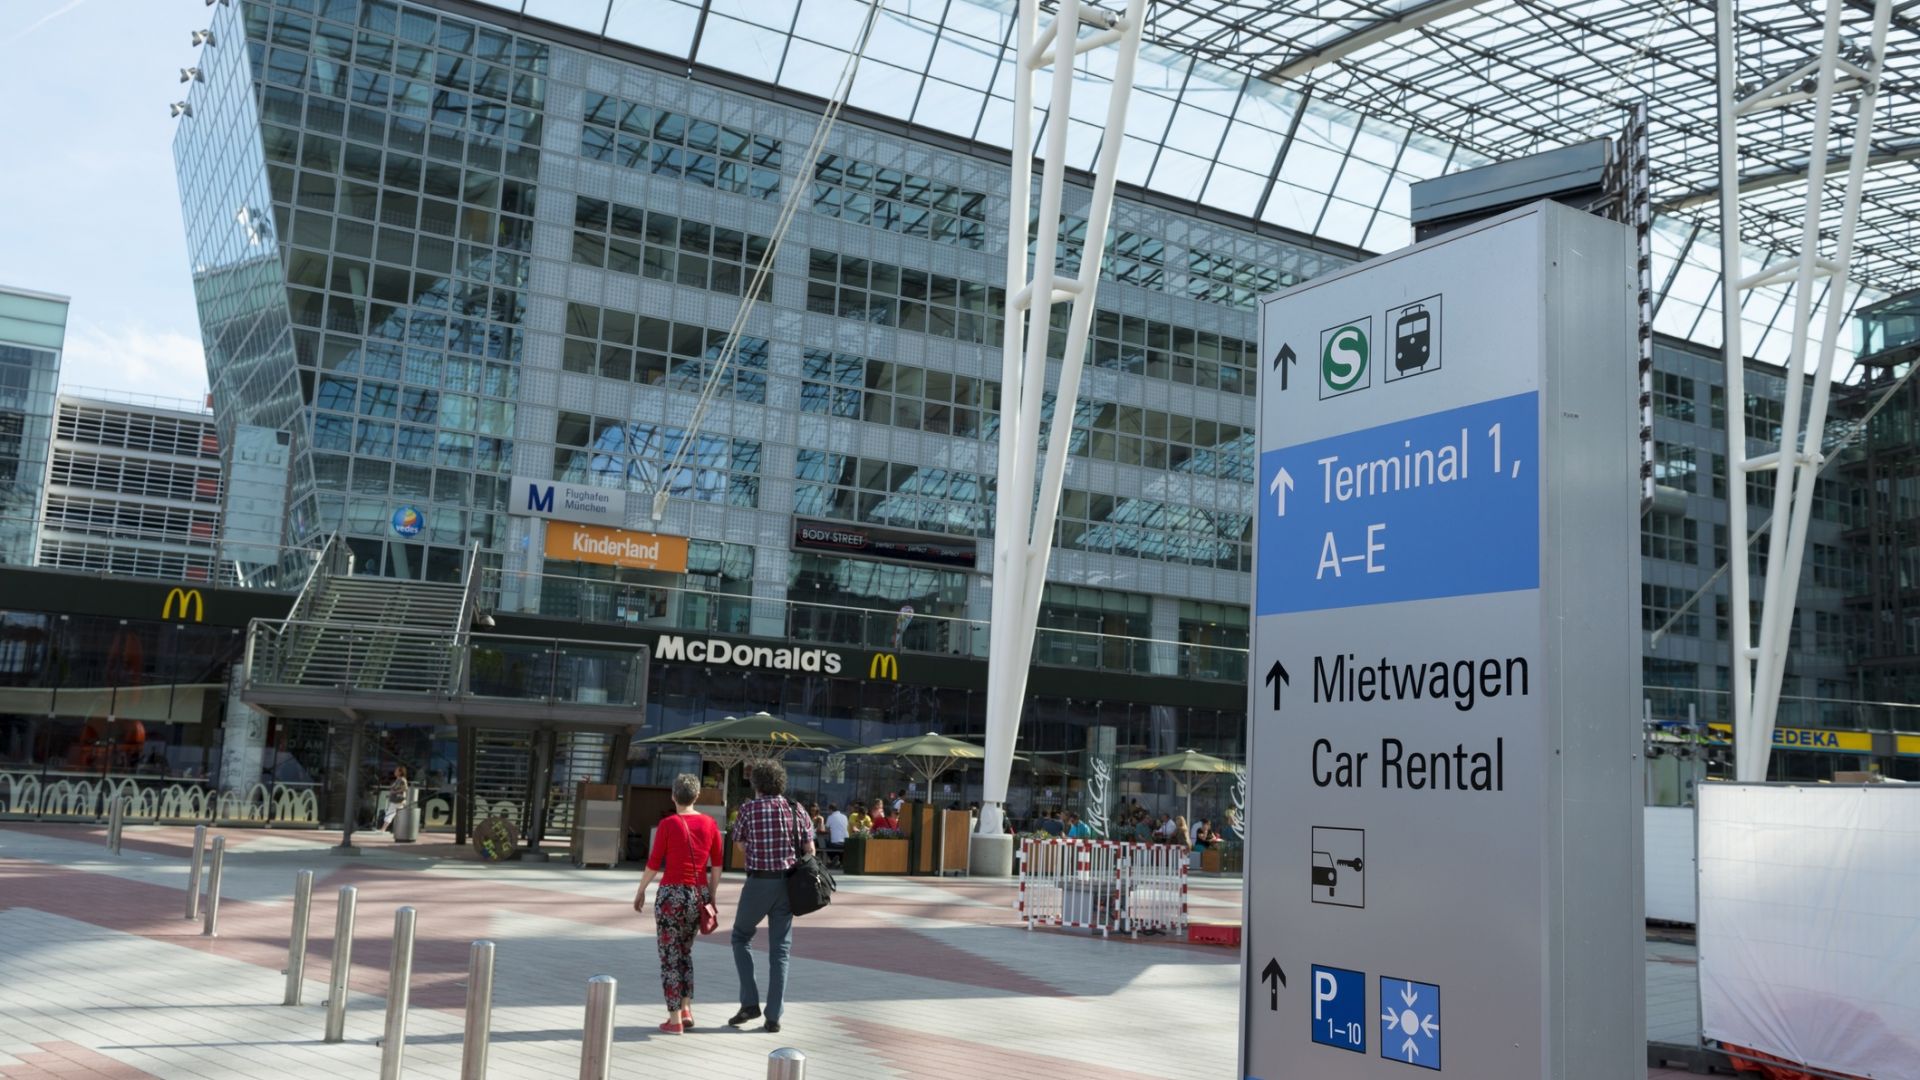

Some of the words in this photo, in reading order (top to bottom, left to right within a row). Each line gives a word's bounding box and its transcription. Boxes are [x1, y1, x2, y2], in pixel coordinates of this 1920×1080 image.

[1318, 428, 1468, 503] Terminal
[1488, 423, 1521, 479] 1,
[528, 484, 555, 513] M
[565, 488, 609, 503] Flughafen
[565, 499, 607, 514] München
[395, 524, 418, 534] vedes
[802, 528, 831, 542] BODY
[832, 532, 864, 545] STREET
[573, 532, 660, 561] Kinderland
[655, 634, 842, 674] McDonald's
[1313, 654, 1529, 711] Mietwagen
[1773, 729, 1839, 747] EDEKA
[1312, 738, 1368, 788] Car
[1382, 737, 1504, 791] Rental
[1087, 756, 1111, 838] McCafé
[1315, 970, 1338, 1021] P
